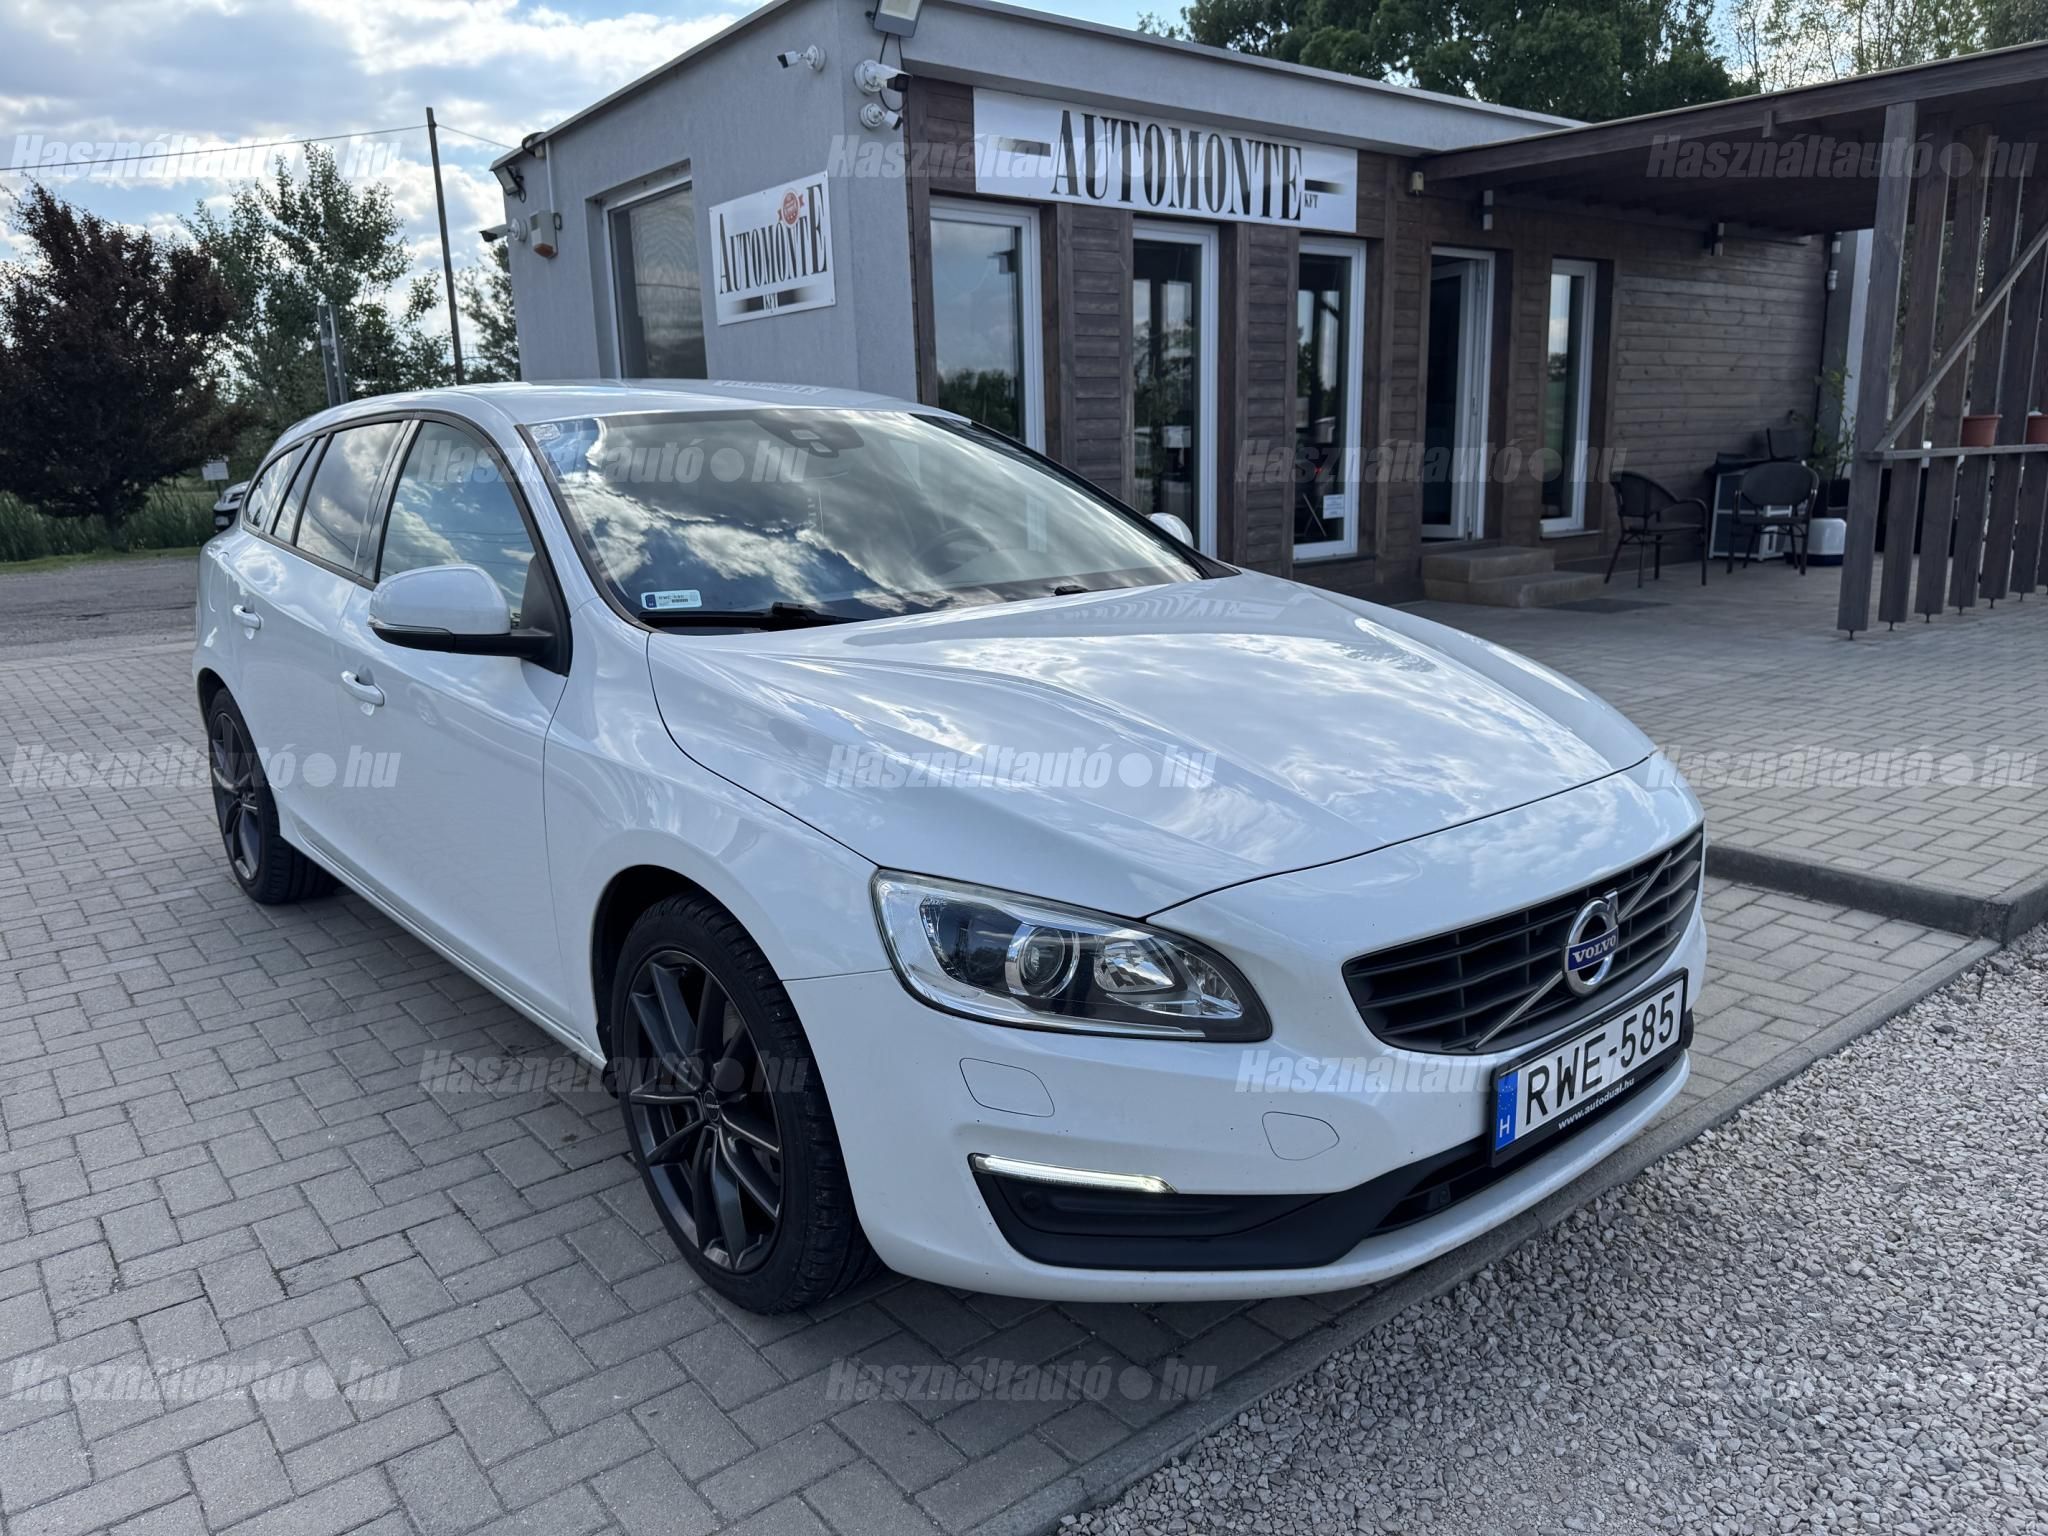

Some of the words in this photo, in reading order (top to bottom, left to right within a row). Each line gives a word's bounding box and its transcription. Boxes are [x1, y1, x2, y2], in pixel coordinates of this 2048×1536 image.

[1051, 110, 1302, 221] AUTOMONTE
[719, 183, 828, 294] AUTOMONTE
[1572, 934, 1617, 963] VOLVO
[1525, 990, 1675, 1126] RWE-585
[1499, 1115, 1510, 1139] H
[1558, 1077, 1635, 1130] www.autodual.hu
